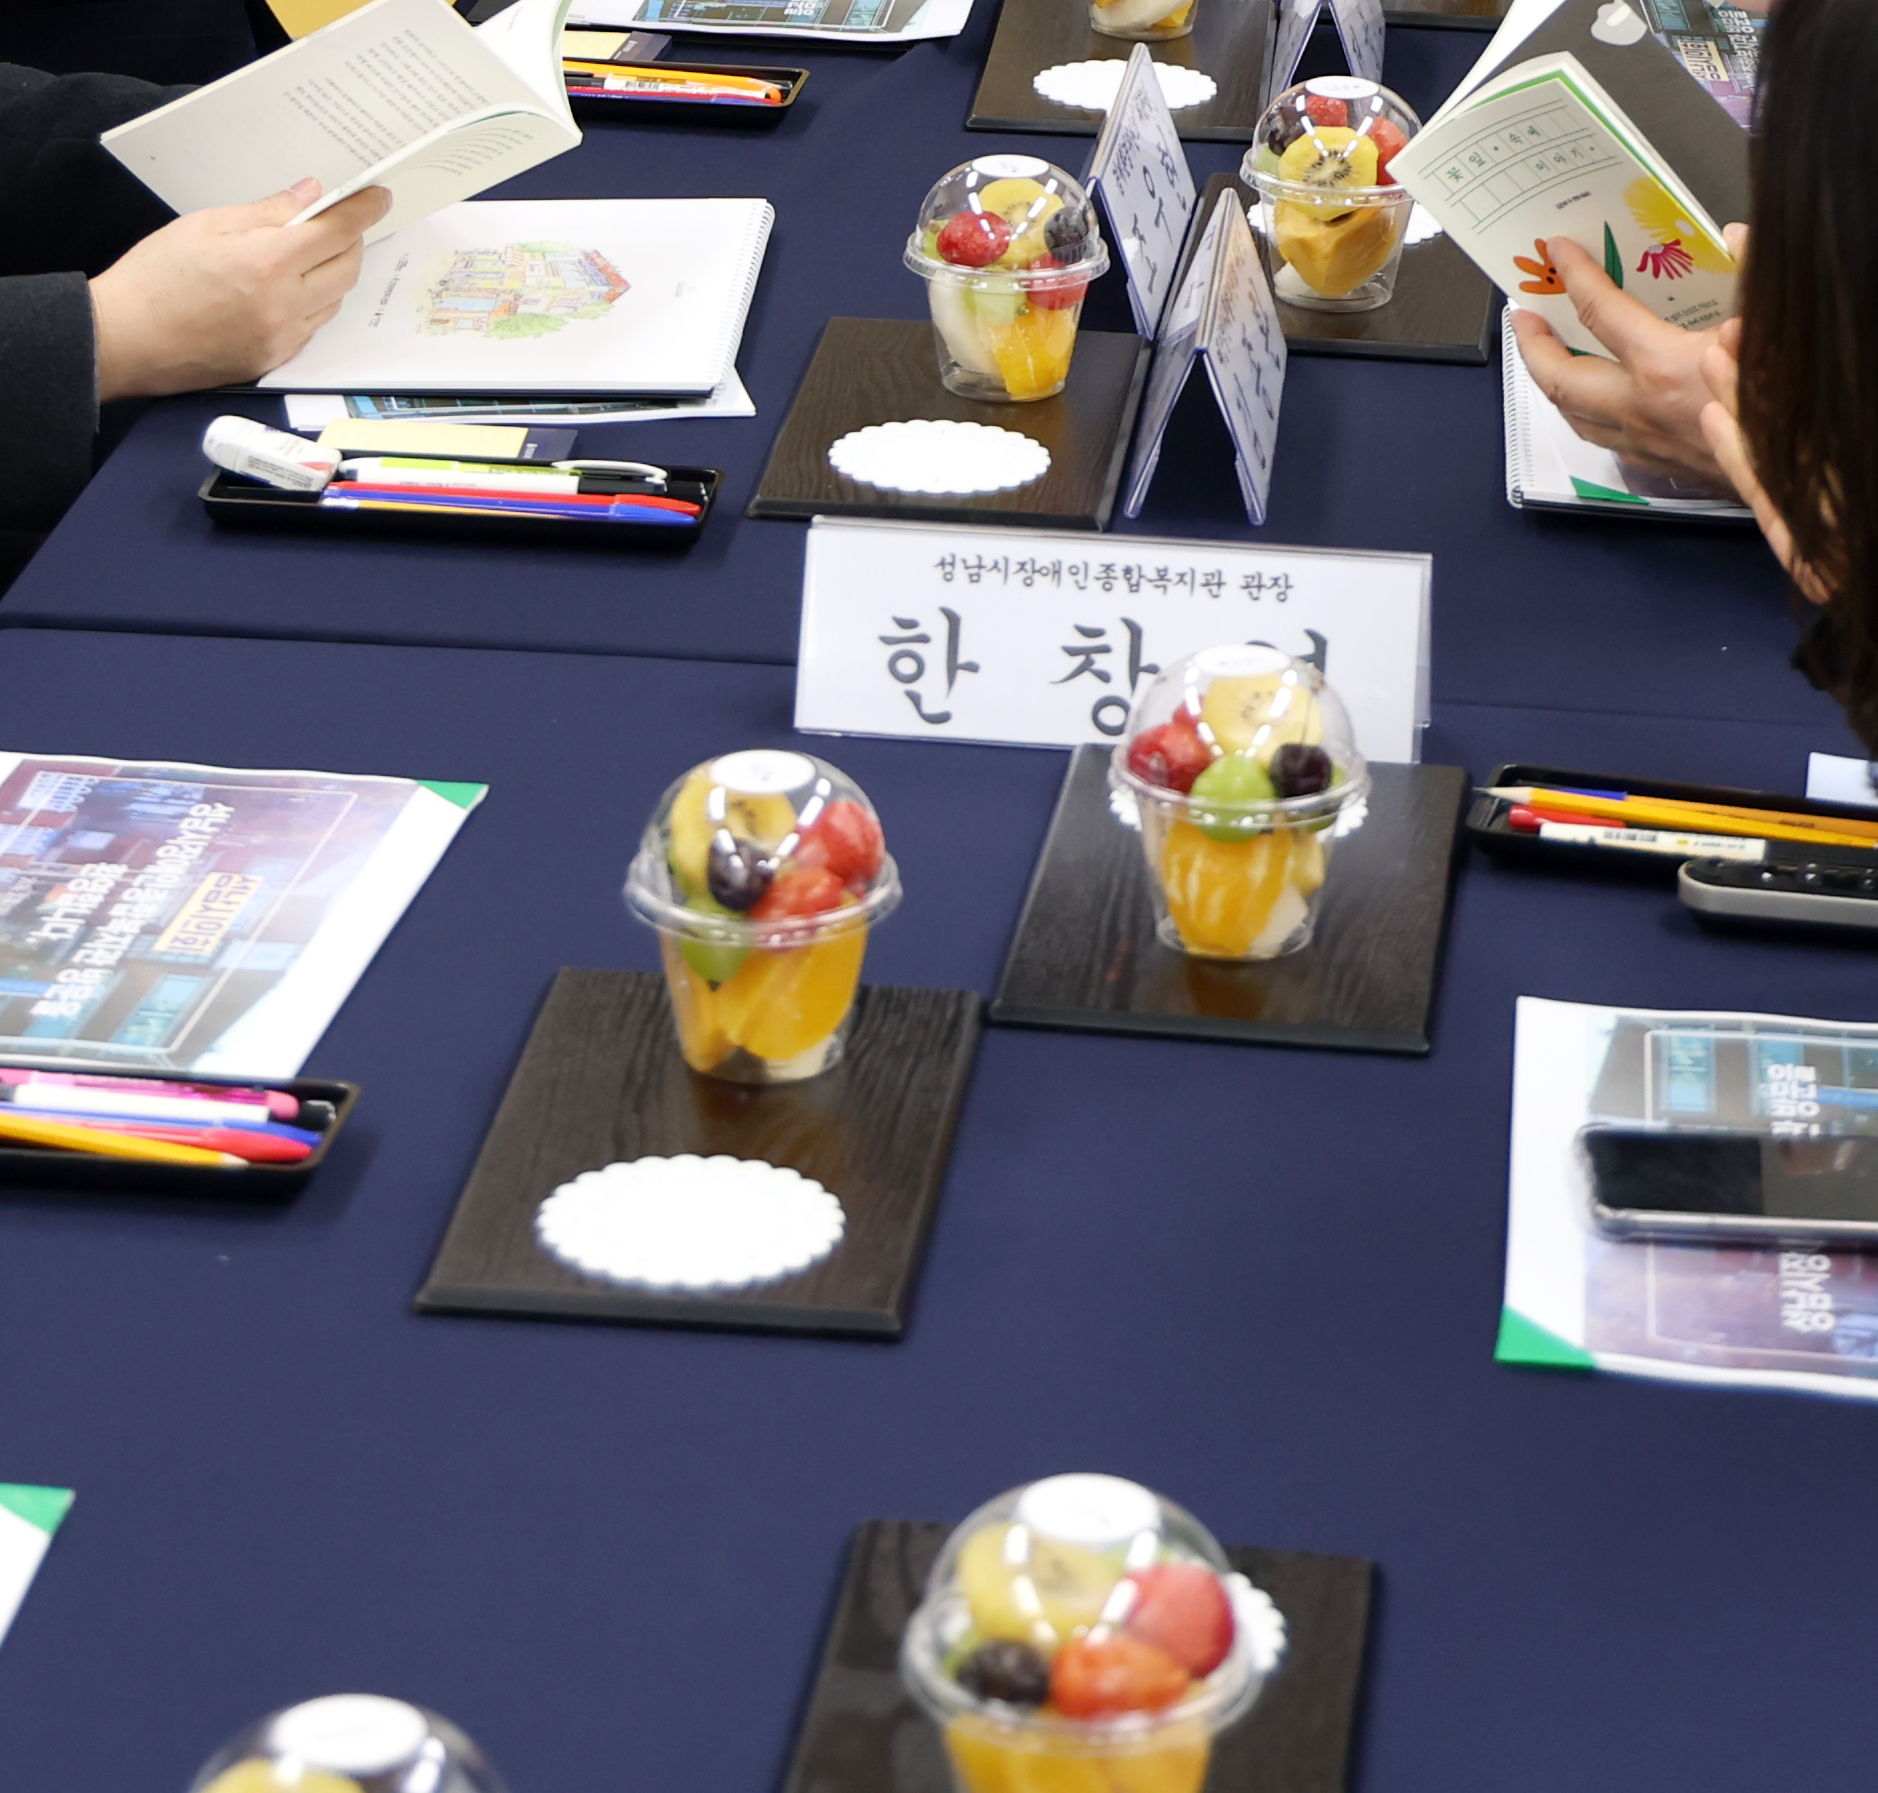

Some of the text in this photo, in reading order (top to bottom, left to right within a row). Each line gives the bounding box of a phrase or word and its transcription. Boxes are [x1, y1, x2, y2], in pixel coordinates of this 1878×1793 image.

[933, 553, 1295, 603] 성남시장애인종합복지관 관장
[878, 606, 980, 725] 한
[26, 860, 129, 945] 환영합니다.
[29, 801, 236, 1018] 성남시장애인종합복지관 방문을
[166, 873, 254, 957] 성남시의회
[1762, 1063, 1822, 1118] 방문을
